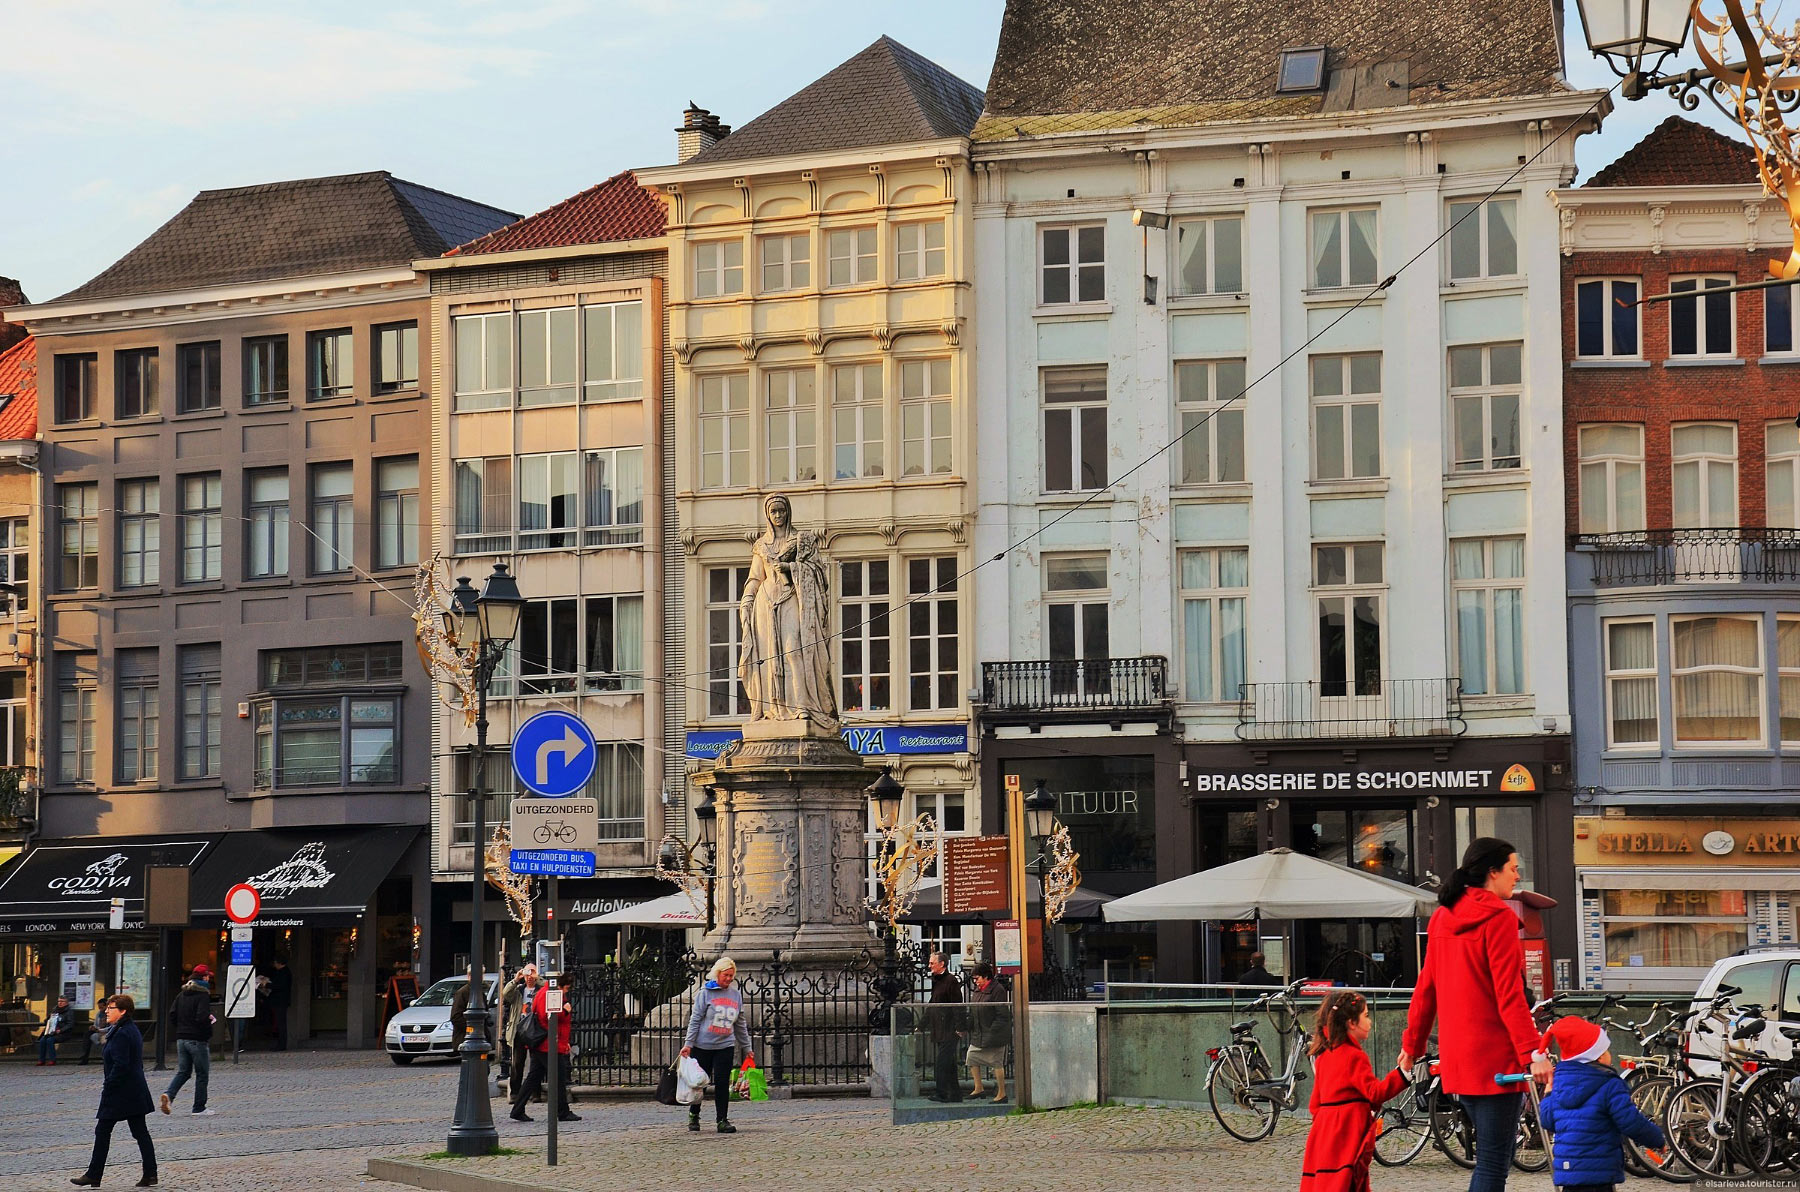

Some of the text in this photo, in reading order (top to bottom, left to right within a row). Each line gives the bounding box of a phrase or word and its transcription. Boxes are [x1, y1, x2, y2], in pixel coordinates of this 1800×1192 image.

[899, 734, 964, 747] Restaurant
[1197, 770, 1492, 791] BRASSERIE DE SCHOENMET
[1507, 773, 1527, 785] Leffe
[1058, 790, 1138, 814] ITUUR
[516, 805, 594, 814] UITGEZONDERD
[1599, 833, 1800, 853] STELLA ART
[517, 852, 586, 864] UITGEZONDERD BUS,
[512, 862, 592, 874] TAXI EN HULPDIENSTEN
[48, 876, 132, 888] GODIVA
[571, 899, 646, 912] AudioNov
[25, 924, 57, 932] LONDON
[70, 923, 87, 931] NEW
[87, 923, 106, 931] YORK
